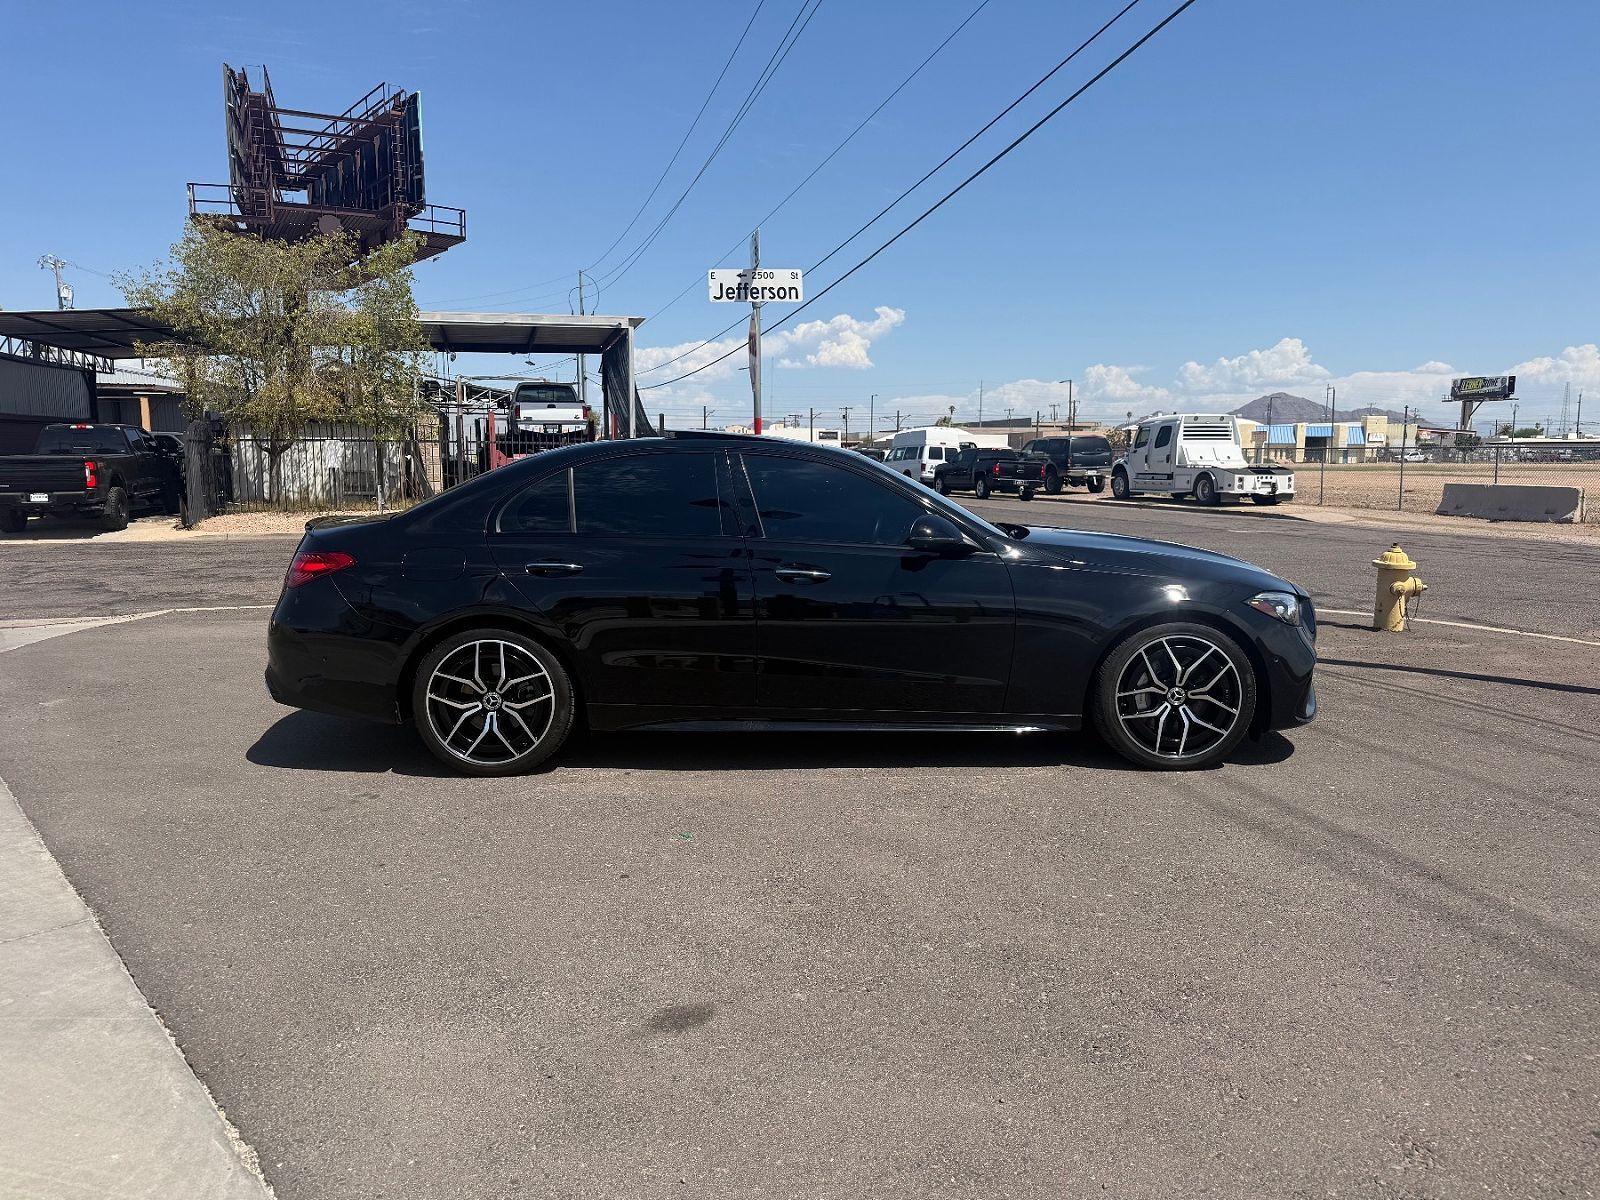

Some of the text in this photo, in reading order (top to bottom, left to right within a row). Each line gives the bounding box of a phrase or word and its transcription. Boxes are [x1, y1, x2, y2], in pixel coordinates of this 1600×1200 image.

[710, 271, 799, 280] E 2500 St
[713, 282, 799, 300] Jefferson
